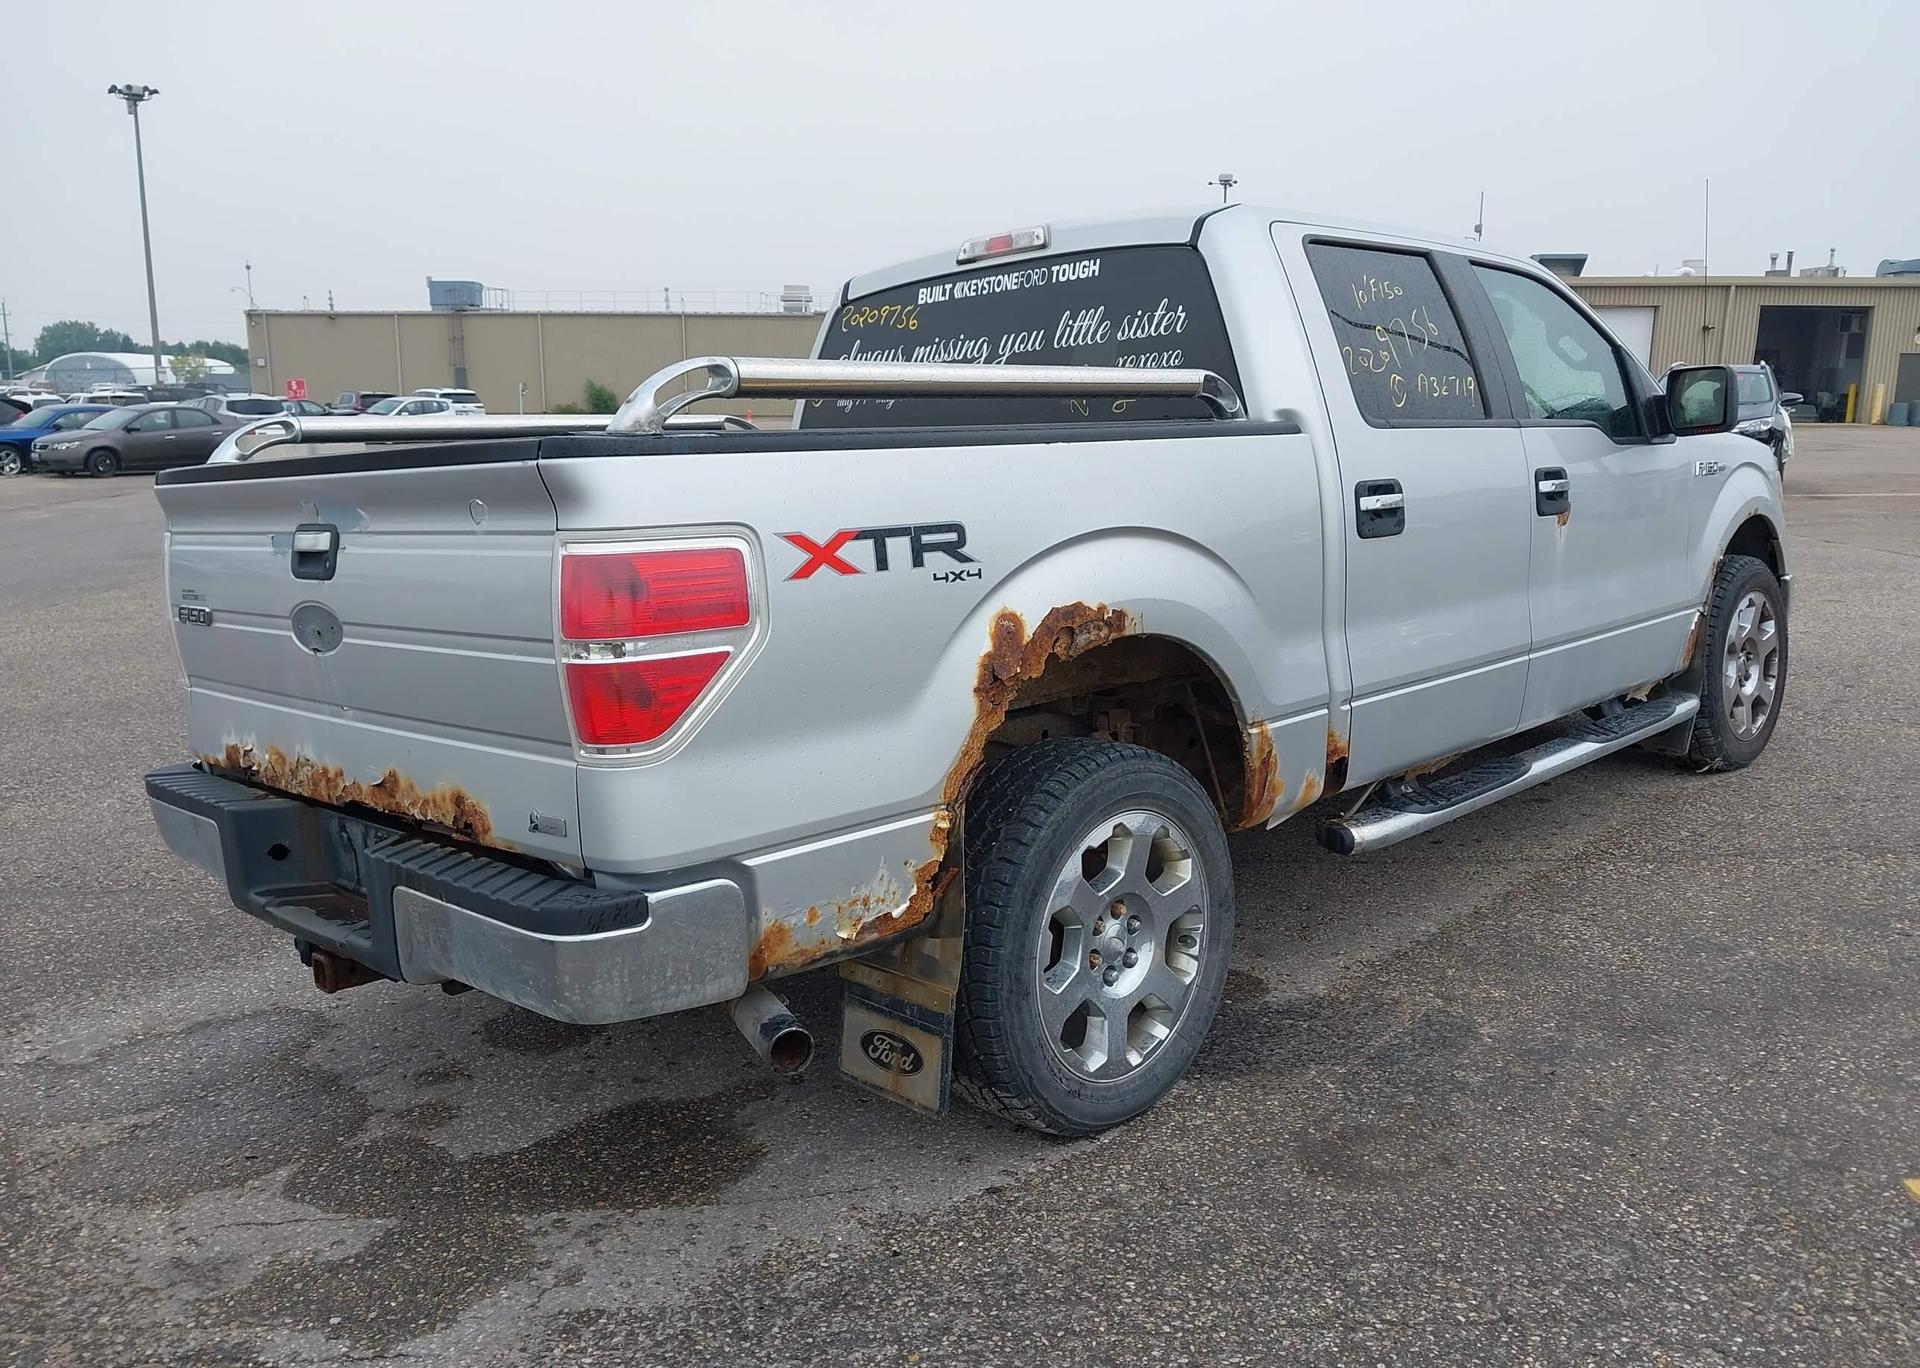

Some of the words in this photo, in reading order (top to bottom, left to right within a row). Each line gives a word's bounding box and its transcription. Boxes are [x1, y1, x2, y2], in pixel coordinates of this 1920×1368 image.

[917, 283, 953, 305] BUILT
[1051, 258, 1101, 284] TOUGH
[841, 304, 921, 333] 20209756
[911, 333, 992, 364] missing
[992, 328, 1046, 365] you
[1053, 305, 1113, 349] little
[1117, 297, 1189, 341] sister
[773, 520, 983, 583] XTR
[867, 1034, 916, 1071] Ford
